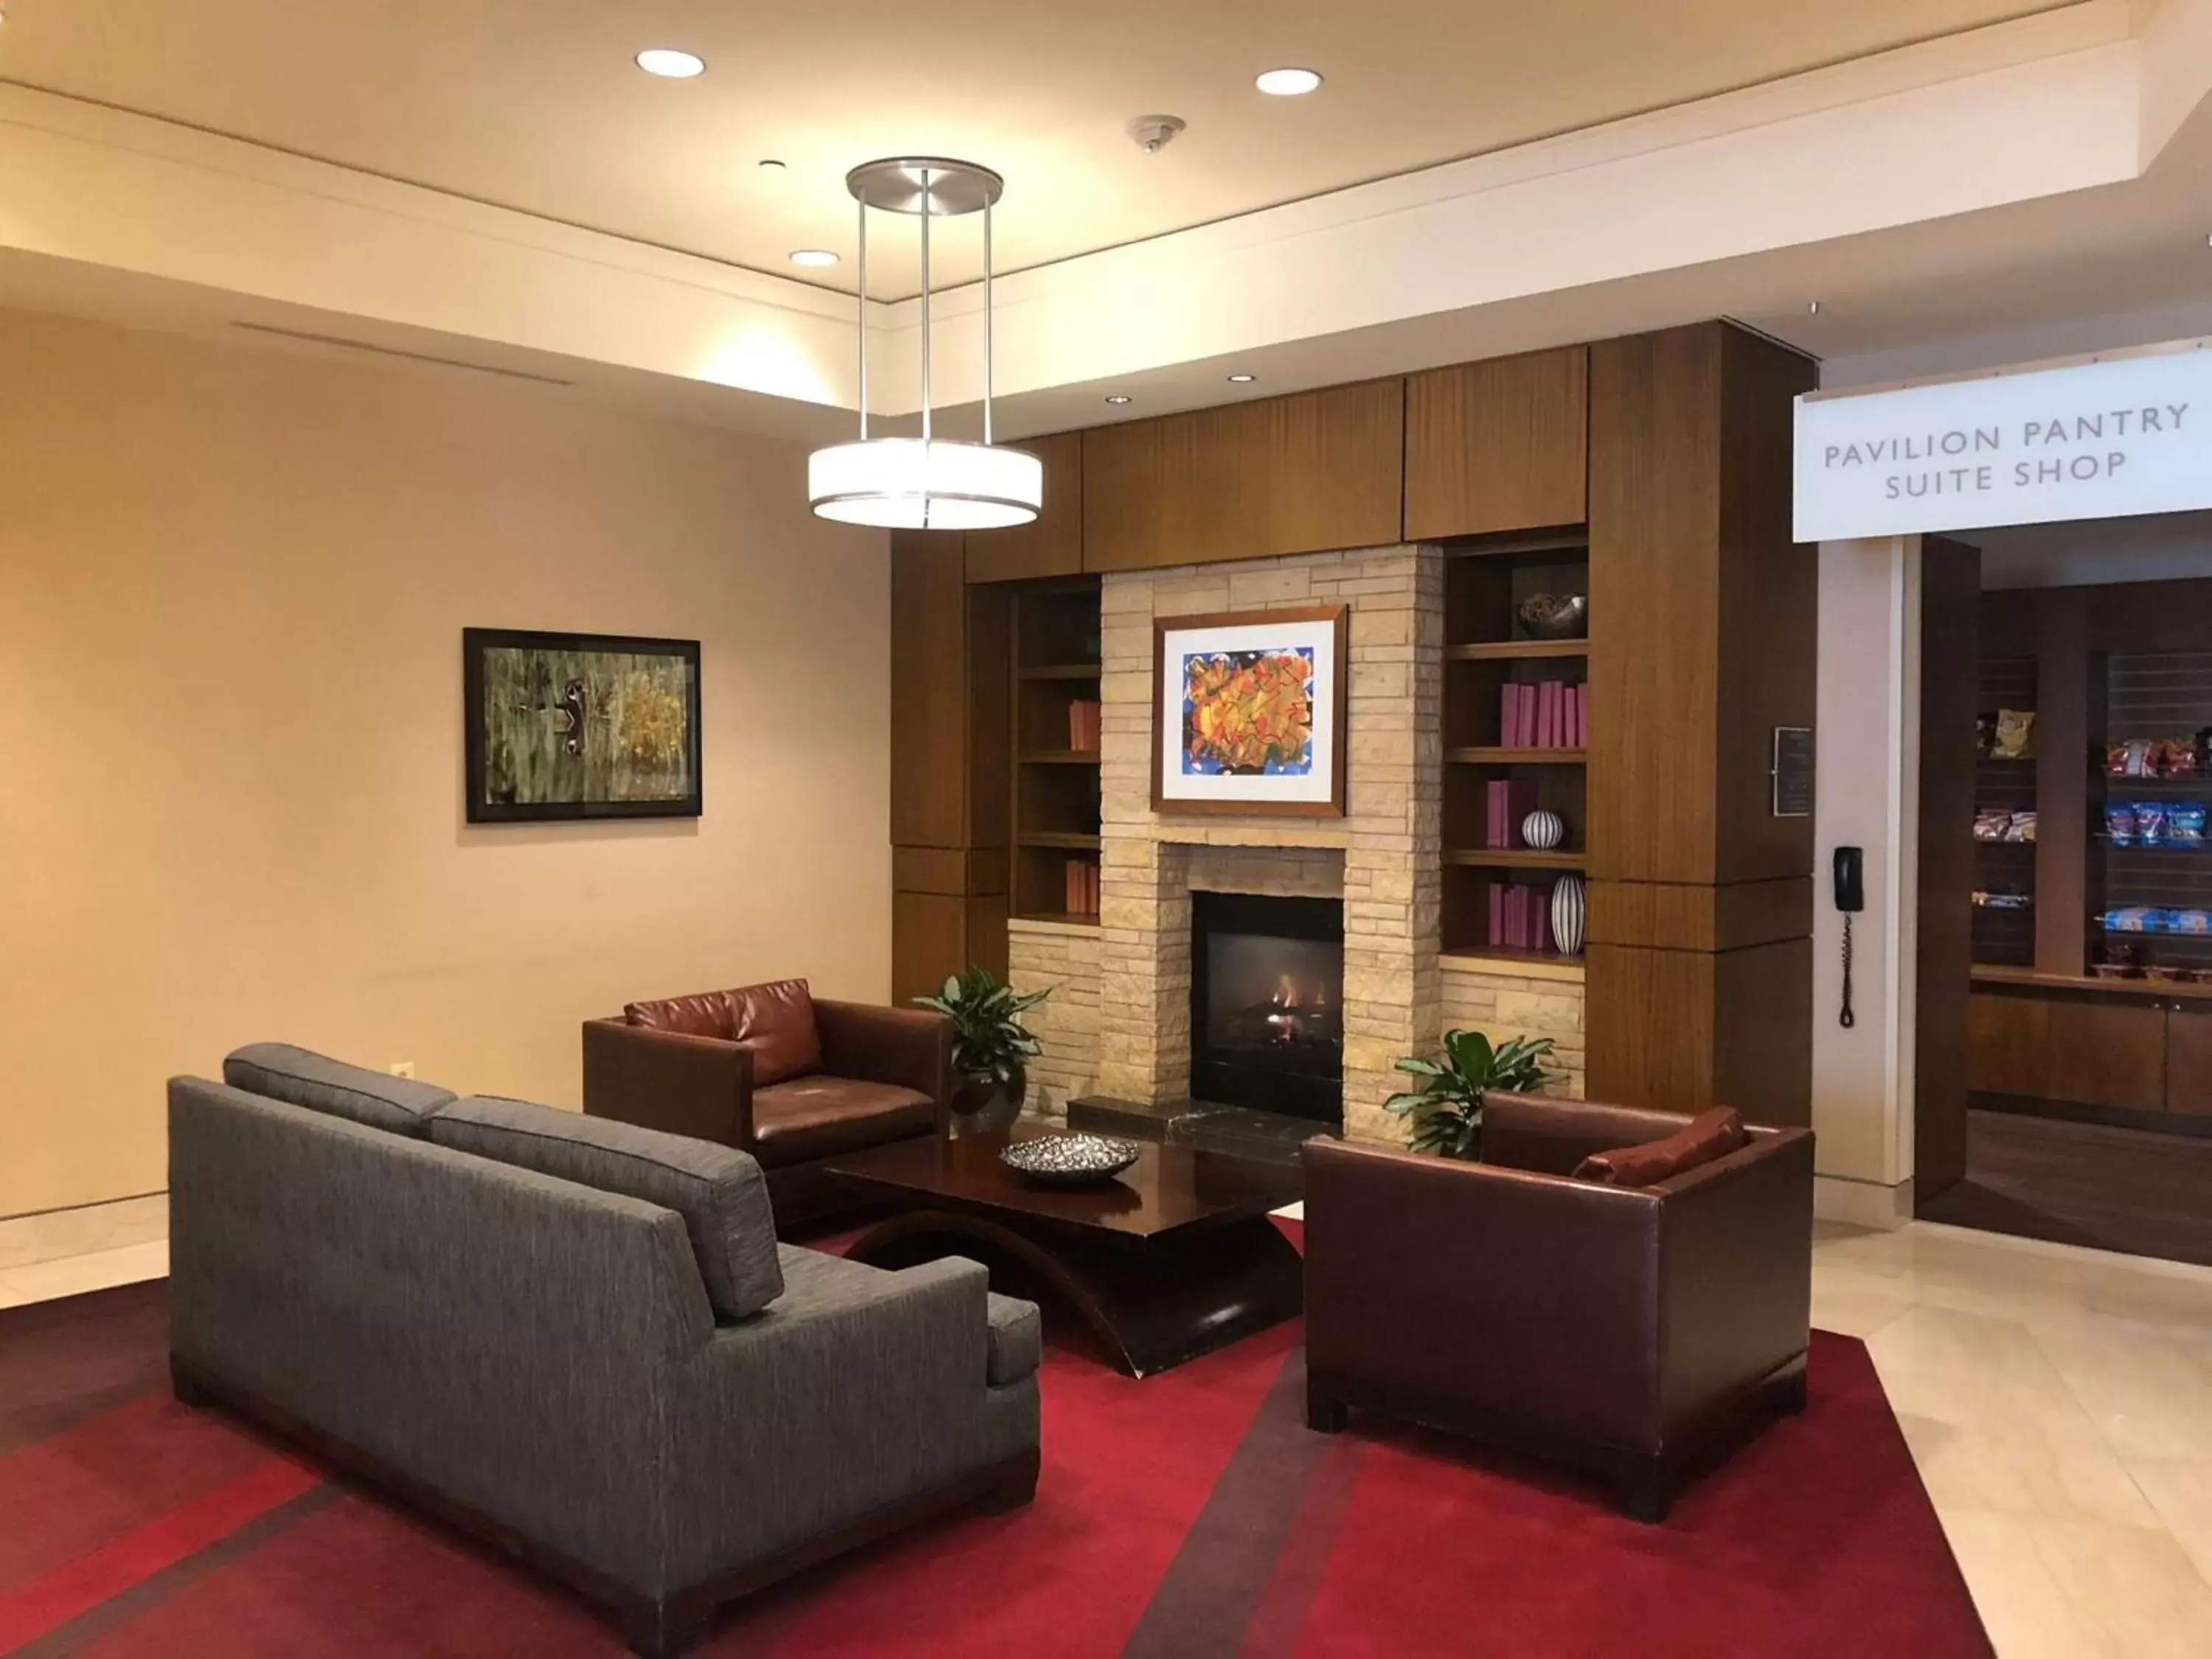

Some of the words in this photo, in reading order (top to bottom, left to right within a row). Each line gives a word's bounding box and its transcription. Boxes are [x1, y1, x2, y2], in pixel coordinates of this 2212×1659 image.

[1825, 426, 2000, 468] PAVILION
[2024, 403, 2189, 446] PANTRY
[1885, 466, 1992, 500] SUITE
[2014, 452, 2126, 487] SHOP
